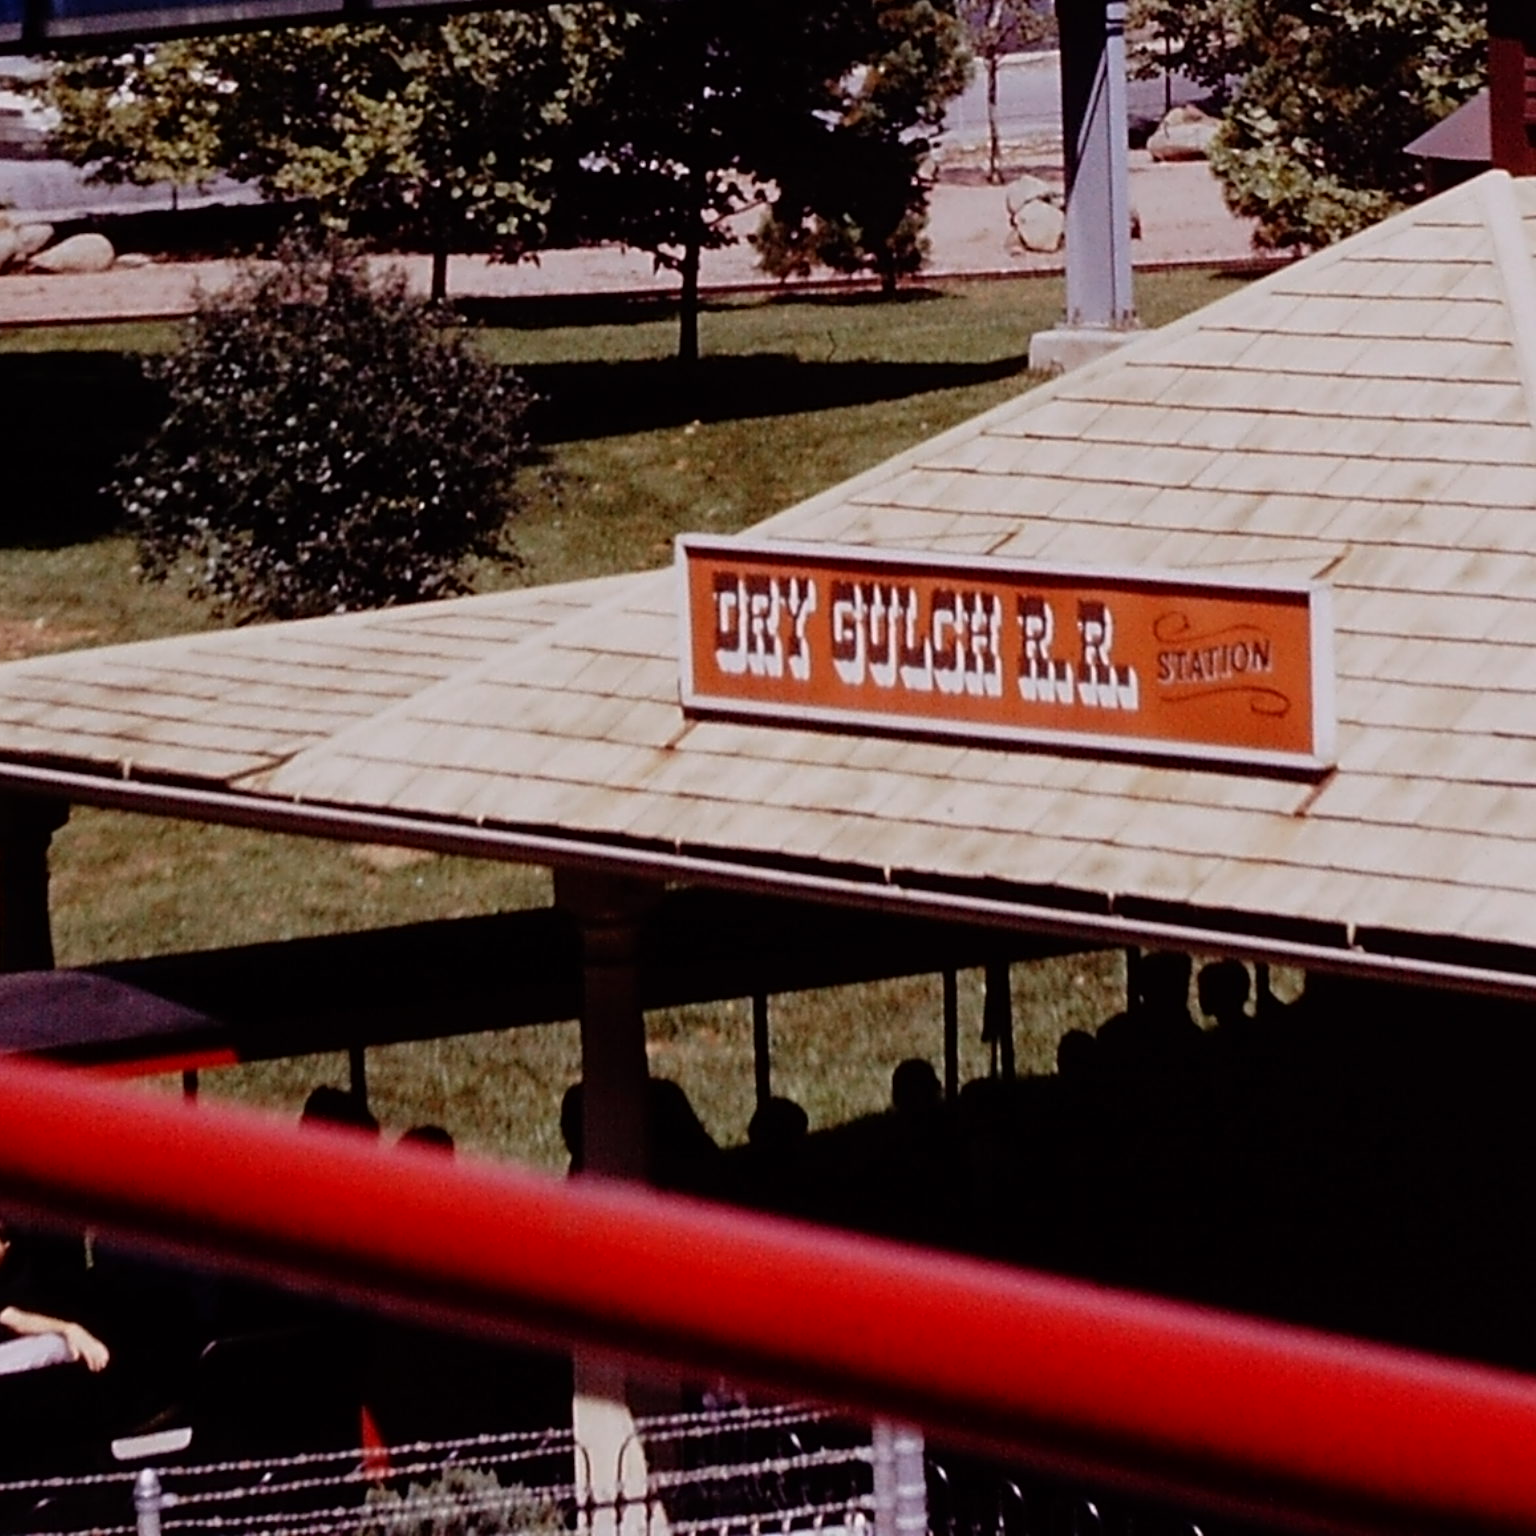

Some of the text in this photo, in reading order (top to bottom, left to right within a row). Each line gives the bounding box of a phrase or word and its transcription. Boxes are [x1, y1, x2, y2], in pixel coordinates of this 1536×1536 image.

[712, 569, 816, 681] DRY
[831, 578, 1002, 697] GULCH
[1156, 639, 1273, 683] STATION
